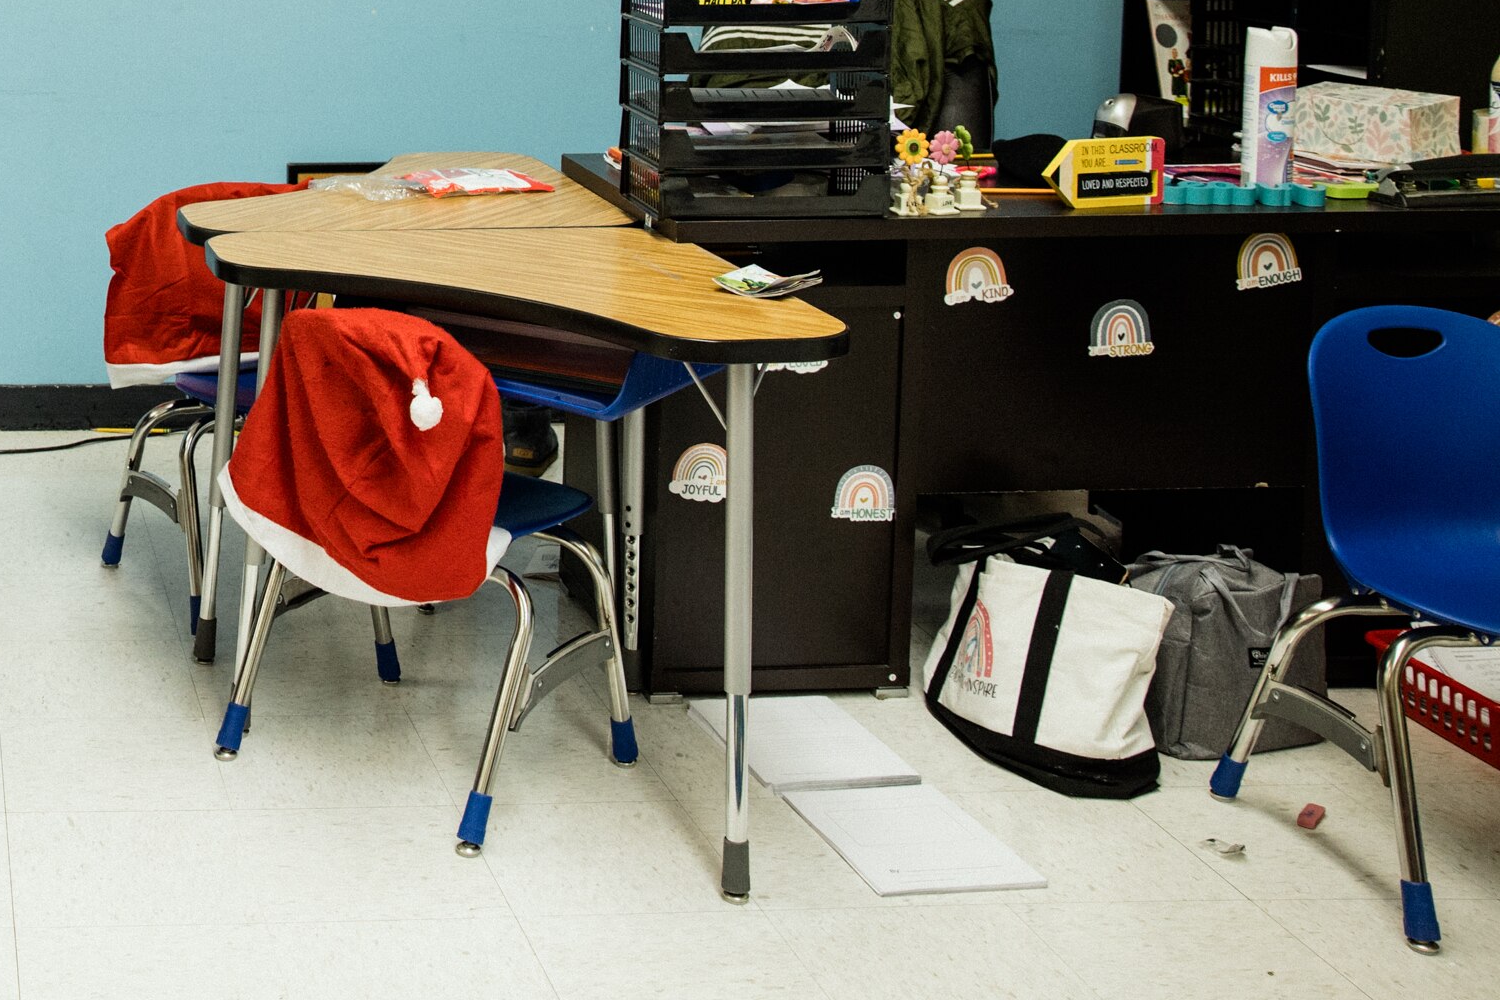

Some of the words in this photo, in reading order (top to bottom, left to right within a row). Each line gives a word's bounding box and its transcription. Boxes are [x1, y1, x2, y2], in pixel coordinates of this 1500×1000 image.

[1269, 73, 1293, 82] KILLS
[1081, 146, 1088, 156] IN
[1091, 146, 1105, 156] THIS
[1081, 158, 1092, 168] YOU
[1081, 179, 1100, 191] LOVED
[1101, 178, 1114, 190] AND
[1116, 177, 1149, 188] RESPECTED
[1258, 269, 1301, 287] ENOUGH
[981, 285, 1009, 300] KIND
[1109, 343, 1153, 356] STRONG
[681, 483, 722, 497] JOYFUL
[851, 507, 894, 519] HONEST
